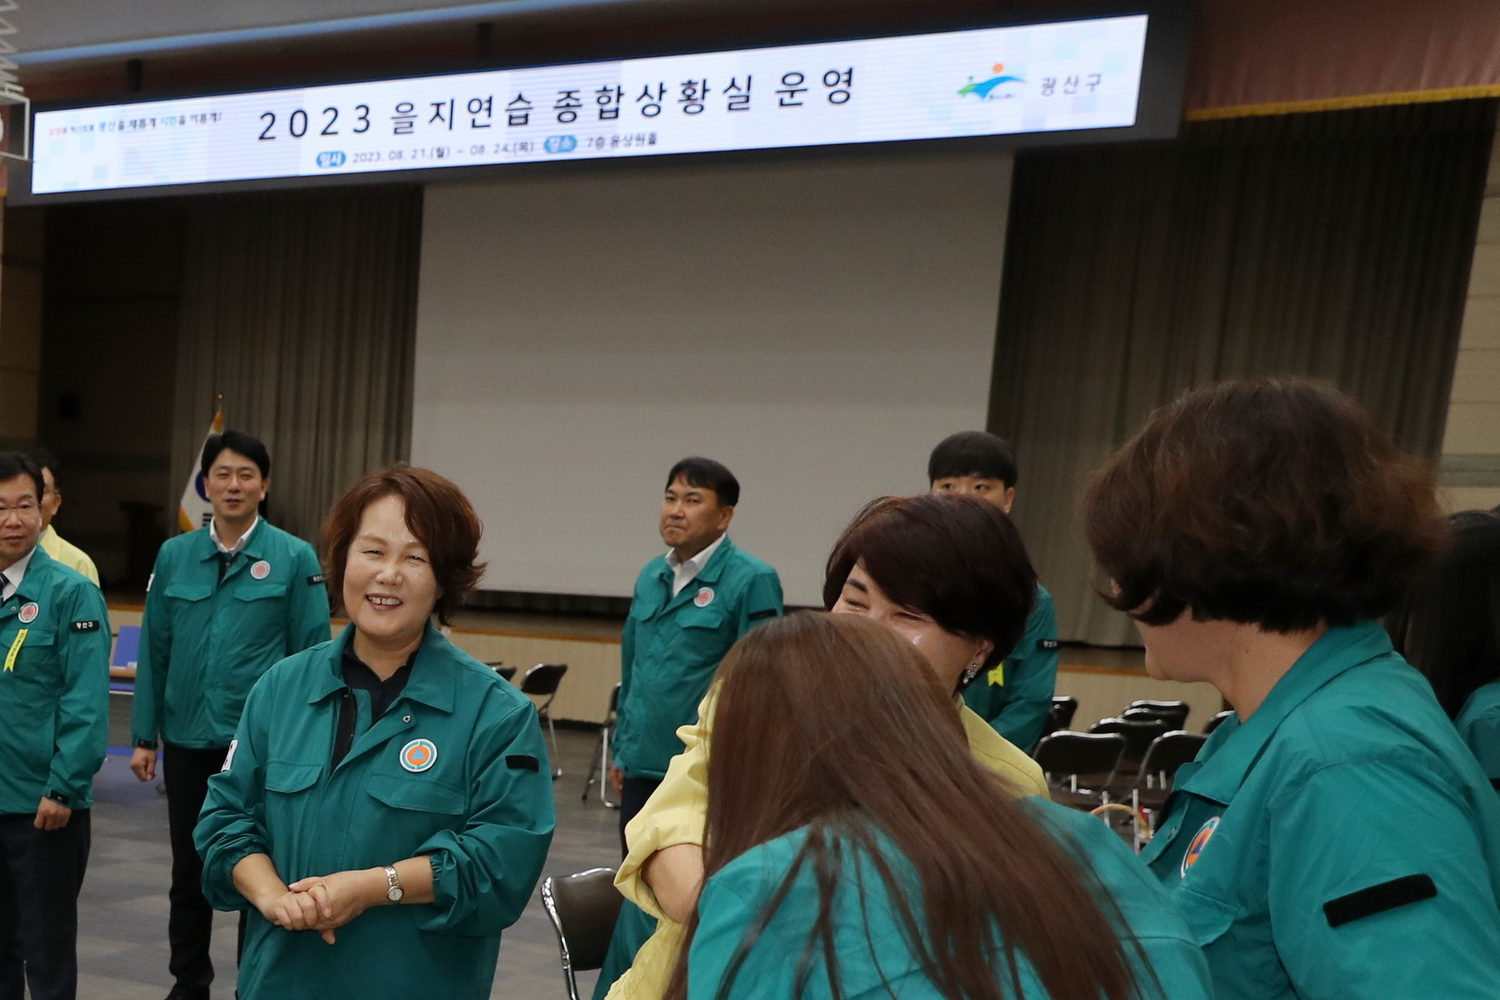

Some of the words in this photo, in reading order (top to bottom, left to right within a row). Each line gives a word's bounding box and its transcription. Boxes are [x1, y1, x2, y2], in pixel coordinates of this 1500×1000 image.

[258, 104, 371, 141] 2023
[390, 92, 533, 135] 을지연습
[553, 74, 753, 123] 종합상황실
[775, 67, 854, 106] 운영
[1041, 73, 1102, 96] 광산구
